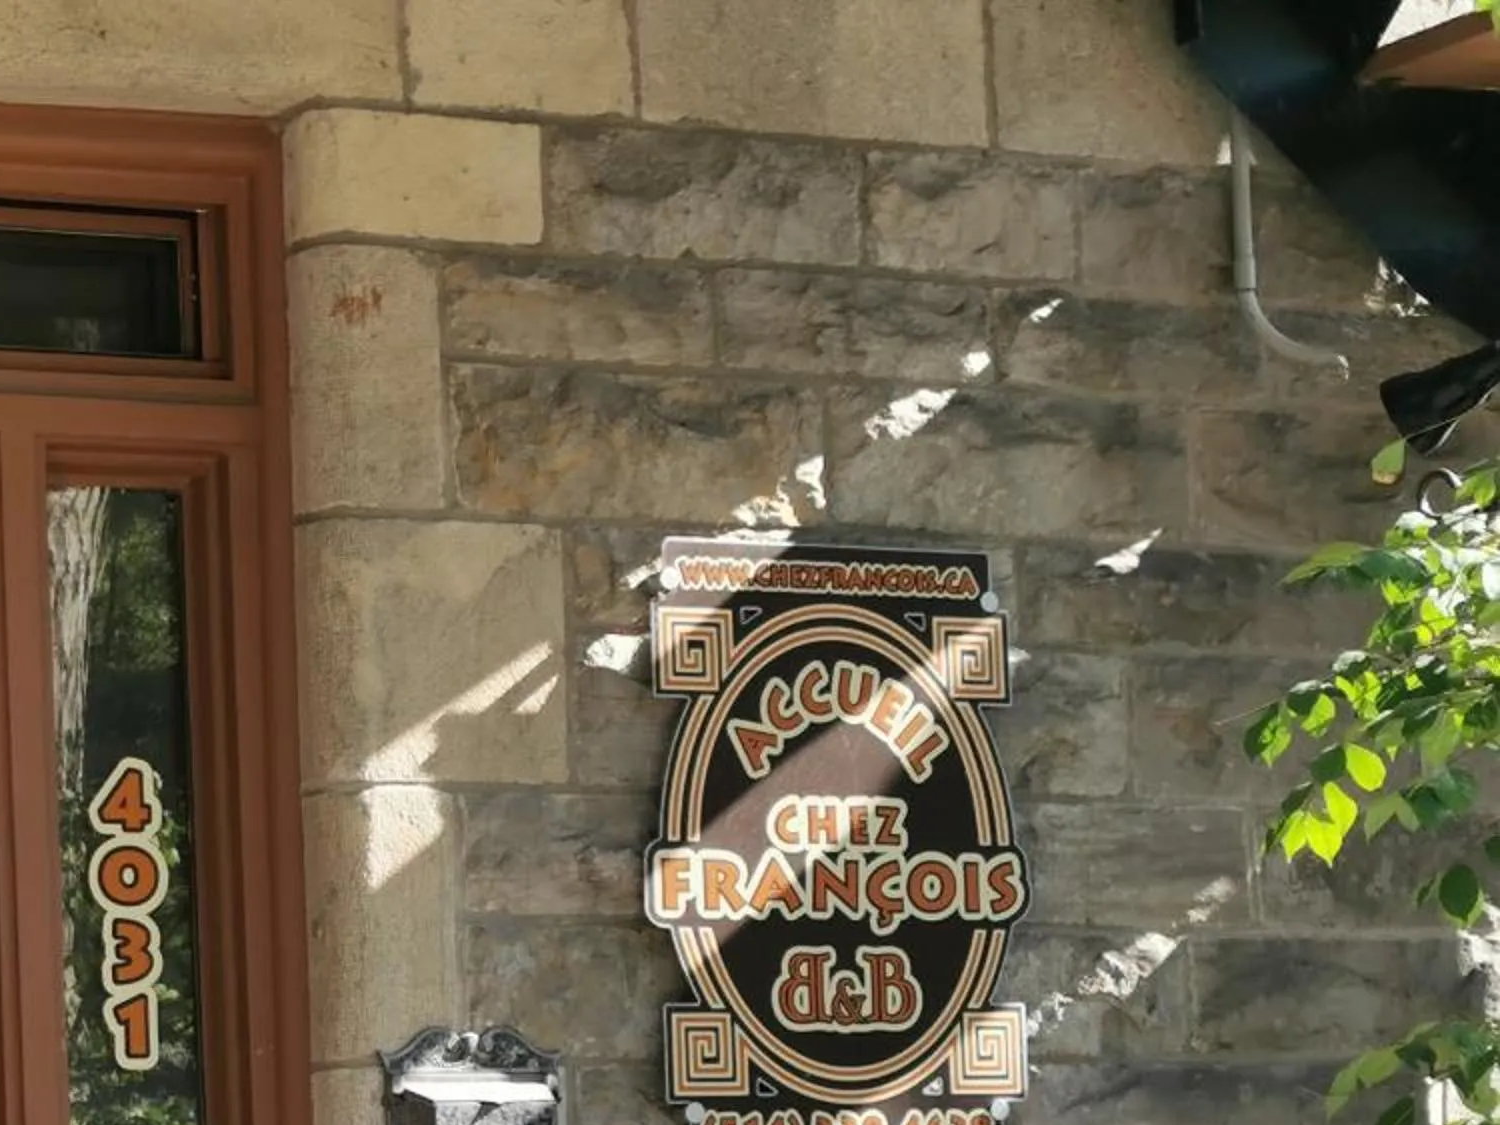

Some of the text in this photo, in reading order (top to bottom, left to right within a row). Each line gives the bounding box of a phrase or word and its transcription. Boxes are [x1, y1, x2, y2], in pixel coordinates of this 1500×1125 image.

[679, 557, 978, 599] WWW.CHEZFRANCOIS.CA
[731, 662, 947, 776] ACCUEIL
[770, 799, 904, 850] CHEZ
[93, 761, 164, 1065] 4031
[653, 852, 1022, 931] FRANÇOIS
[776, 949, 919, 1031] B&B
